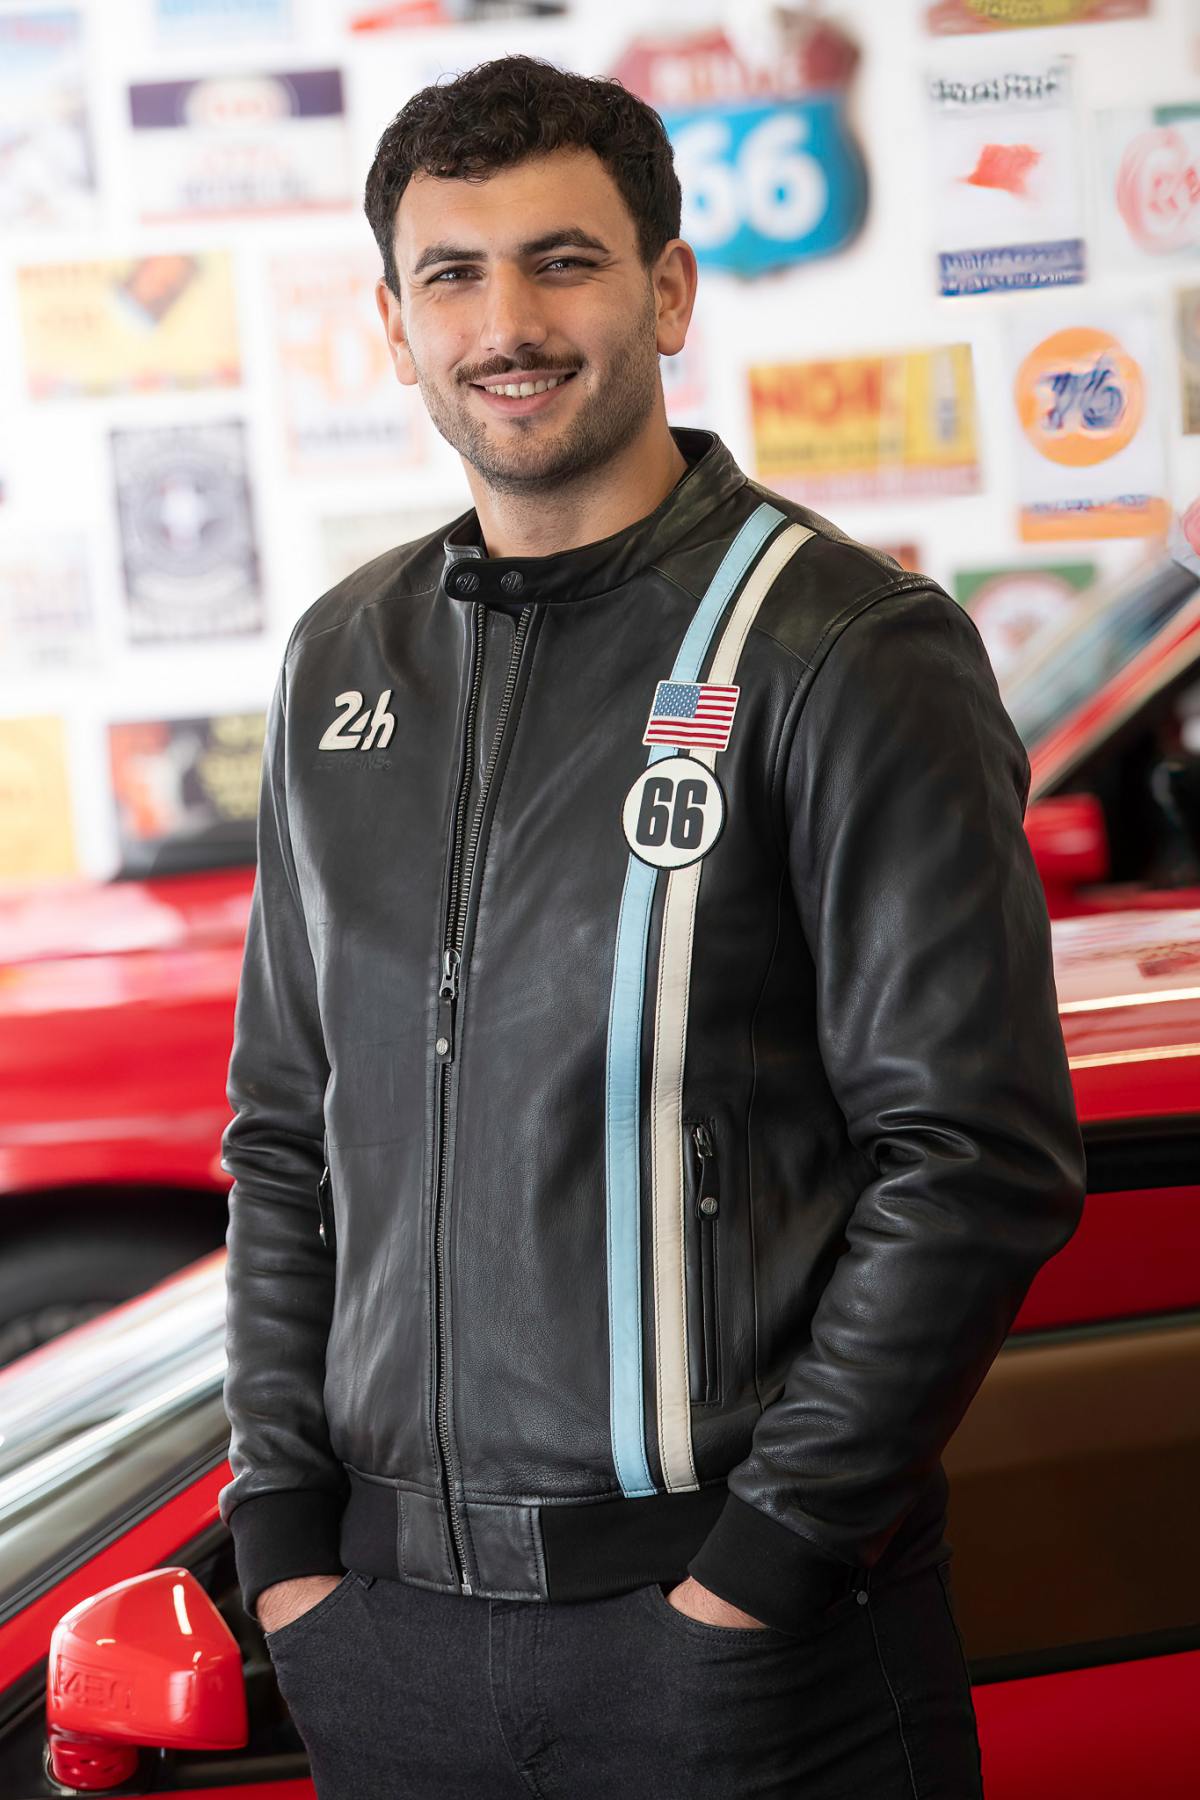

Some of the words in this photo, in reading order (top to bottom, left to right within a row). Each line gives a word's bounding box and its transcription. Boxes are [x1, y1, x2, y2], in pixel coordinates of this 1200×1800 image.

[673, 113, 829, 248] 66
[1042, 356, 1124, 430] 76
[636, 776, 708, 850] 66
